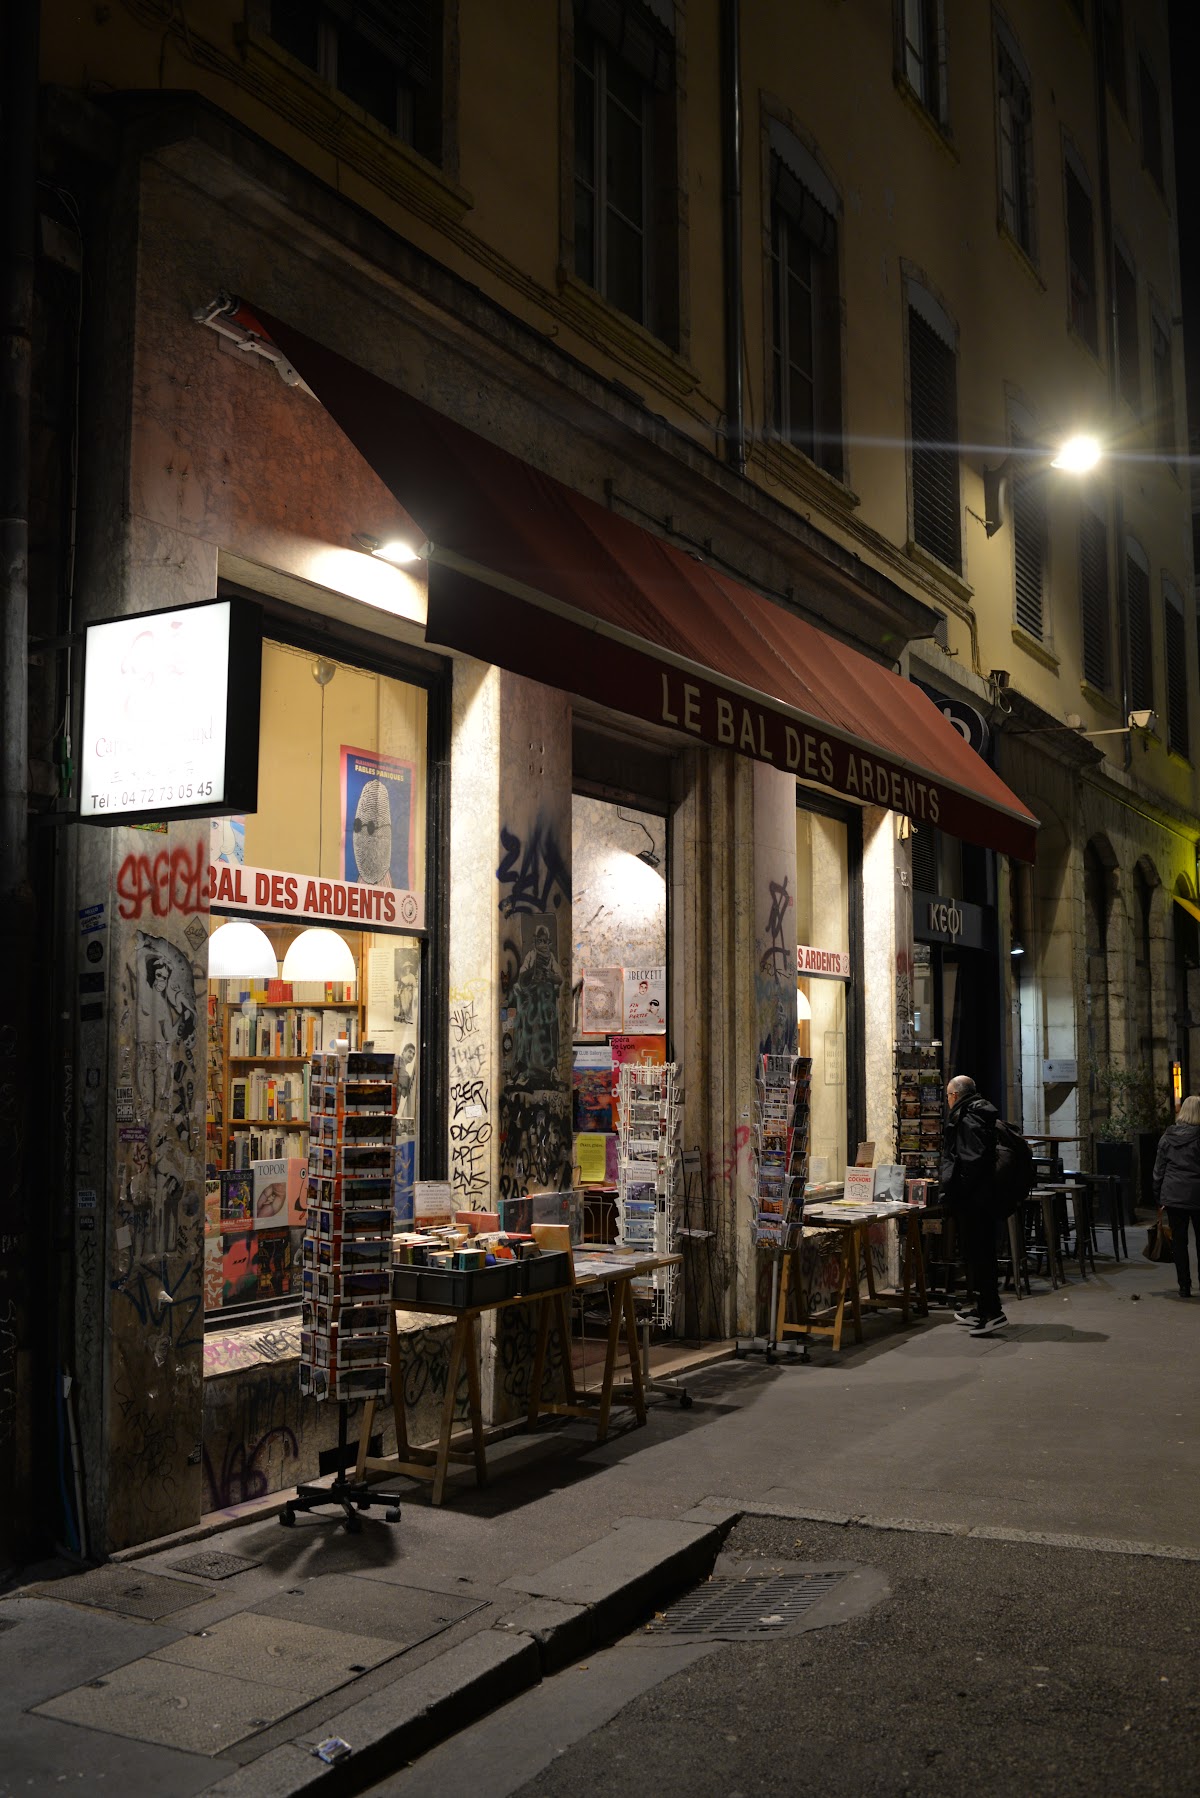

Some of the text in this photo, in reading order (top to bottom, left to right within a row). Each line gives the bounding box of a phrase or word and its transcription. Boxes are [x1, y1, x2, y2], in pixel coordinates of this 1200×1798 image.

[661, 673, 941, 824] LE BAL DES ARDENTS
[354, 764, 376, 776] FABLES
[376, 769, 404, 782] PANIQUES
[90, 792, 110, 809] Tél
[121, 791, 136, 806] 04
[140, 787, 155, 803] 72
[159, 785, 174, 801] 73
[178, 783, 193, 799] 05
[196, 781, 213, 797] 45
[255, 872, 299, 911] DES
[303, 880, 397, 923] ARDENTS
[805, 949, 841, 973] ARDENTS
[631, 969, 663, 980] BECKETT
[620, 1043, 635, 1051] Lyon
[258, 1163, 286, 1176] TOPOR
